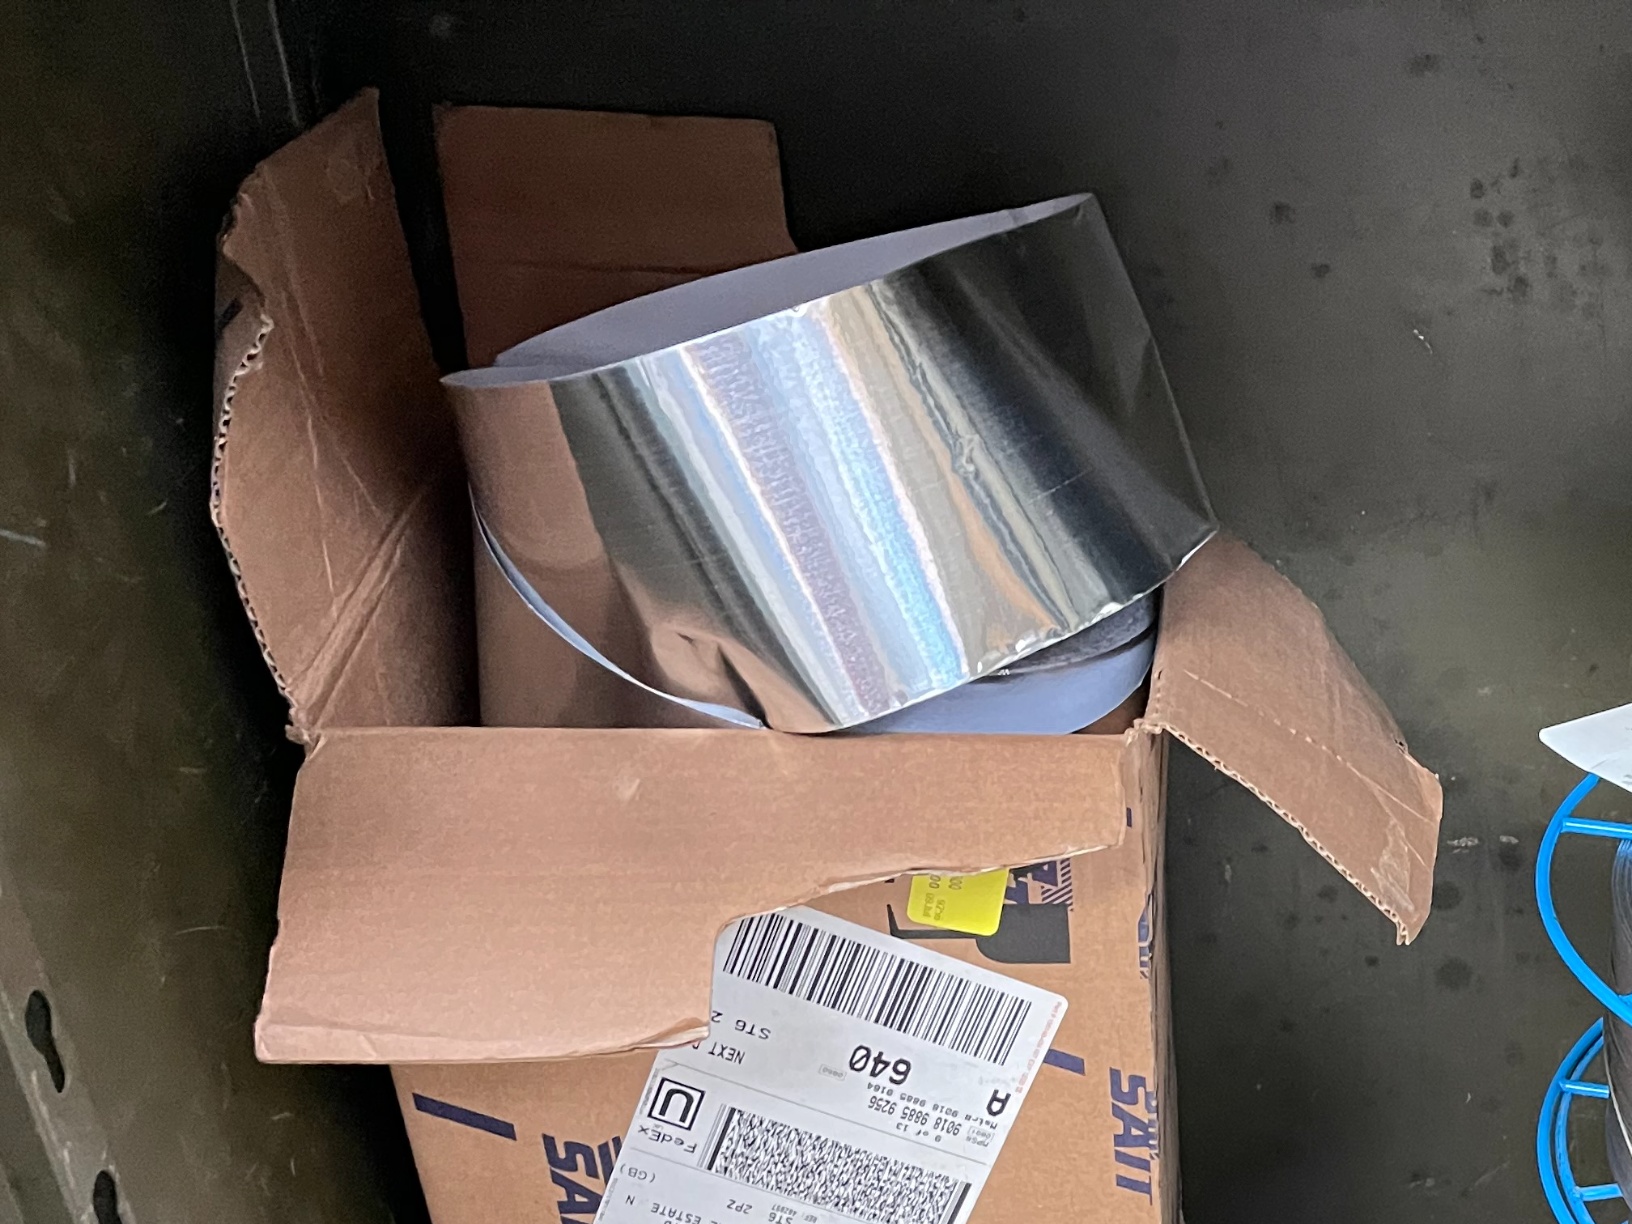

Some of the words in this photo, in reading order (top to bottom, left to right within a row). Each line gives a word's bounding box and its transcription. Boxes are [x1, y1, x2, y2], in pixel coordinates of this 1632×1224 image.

[733, 1018, 772, 1040] ST6
[707, 1040, 745, 1065] NEXT
[846, 1042, 913, 1087] 640
[657, 1085, 696, 1123] U
[866, 1094, 897, 1115] 9256
[984, 1088, 1011, 1118] A
[894, 1121, 908, 1131] 13
[899, 1104, 930, 1126] 9885
[932, 1115, 962, 1136] 9018
[635, 1123, 698, 1154] FedEx
[914, 1127, 929, 1138] of
[1109, 1066, 1153, 1206] SAIT
[624, 1194, 635, 1205] N
[725, 1197, 753, 1215] 2PZ
